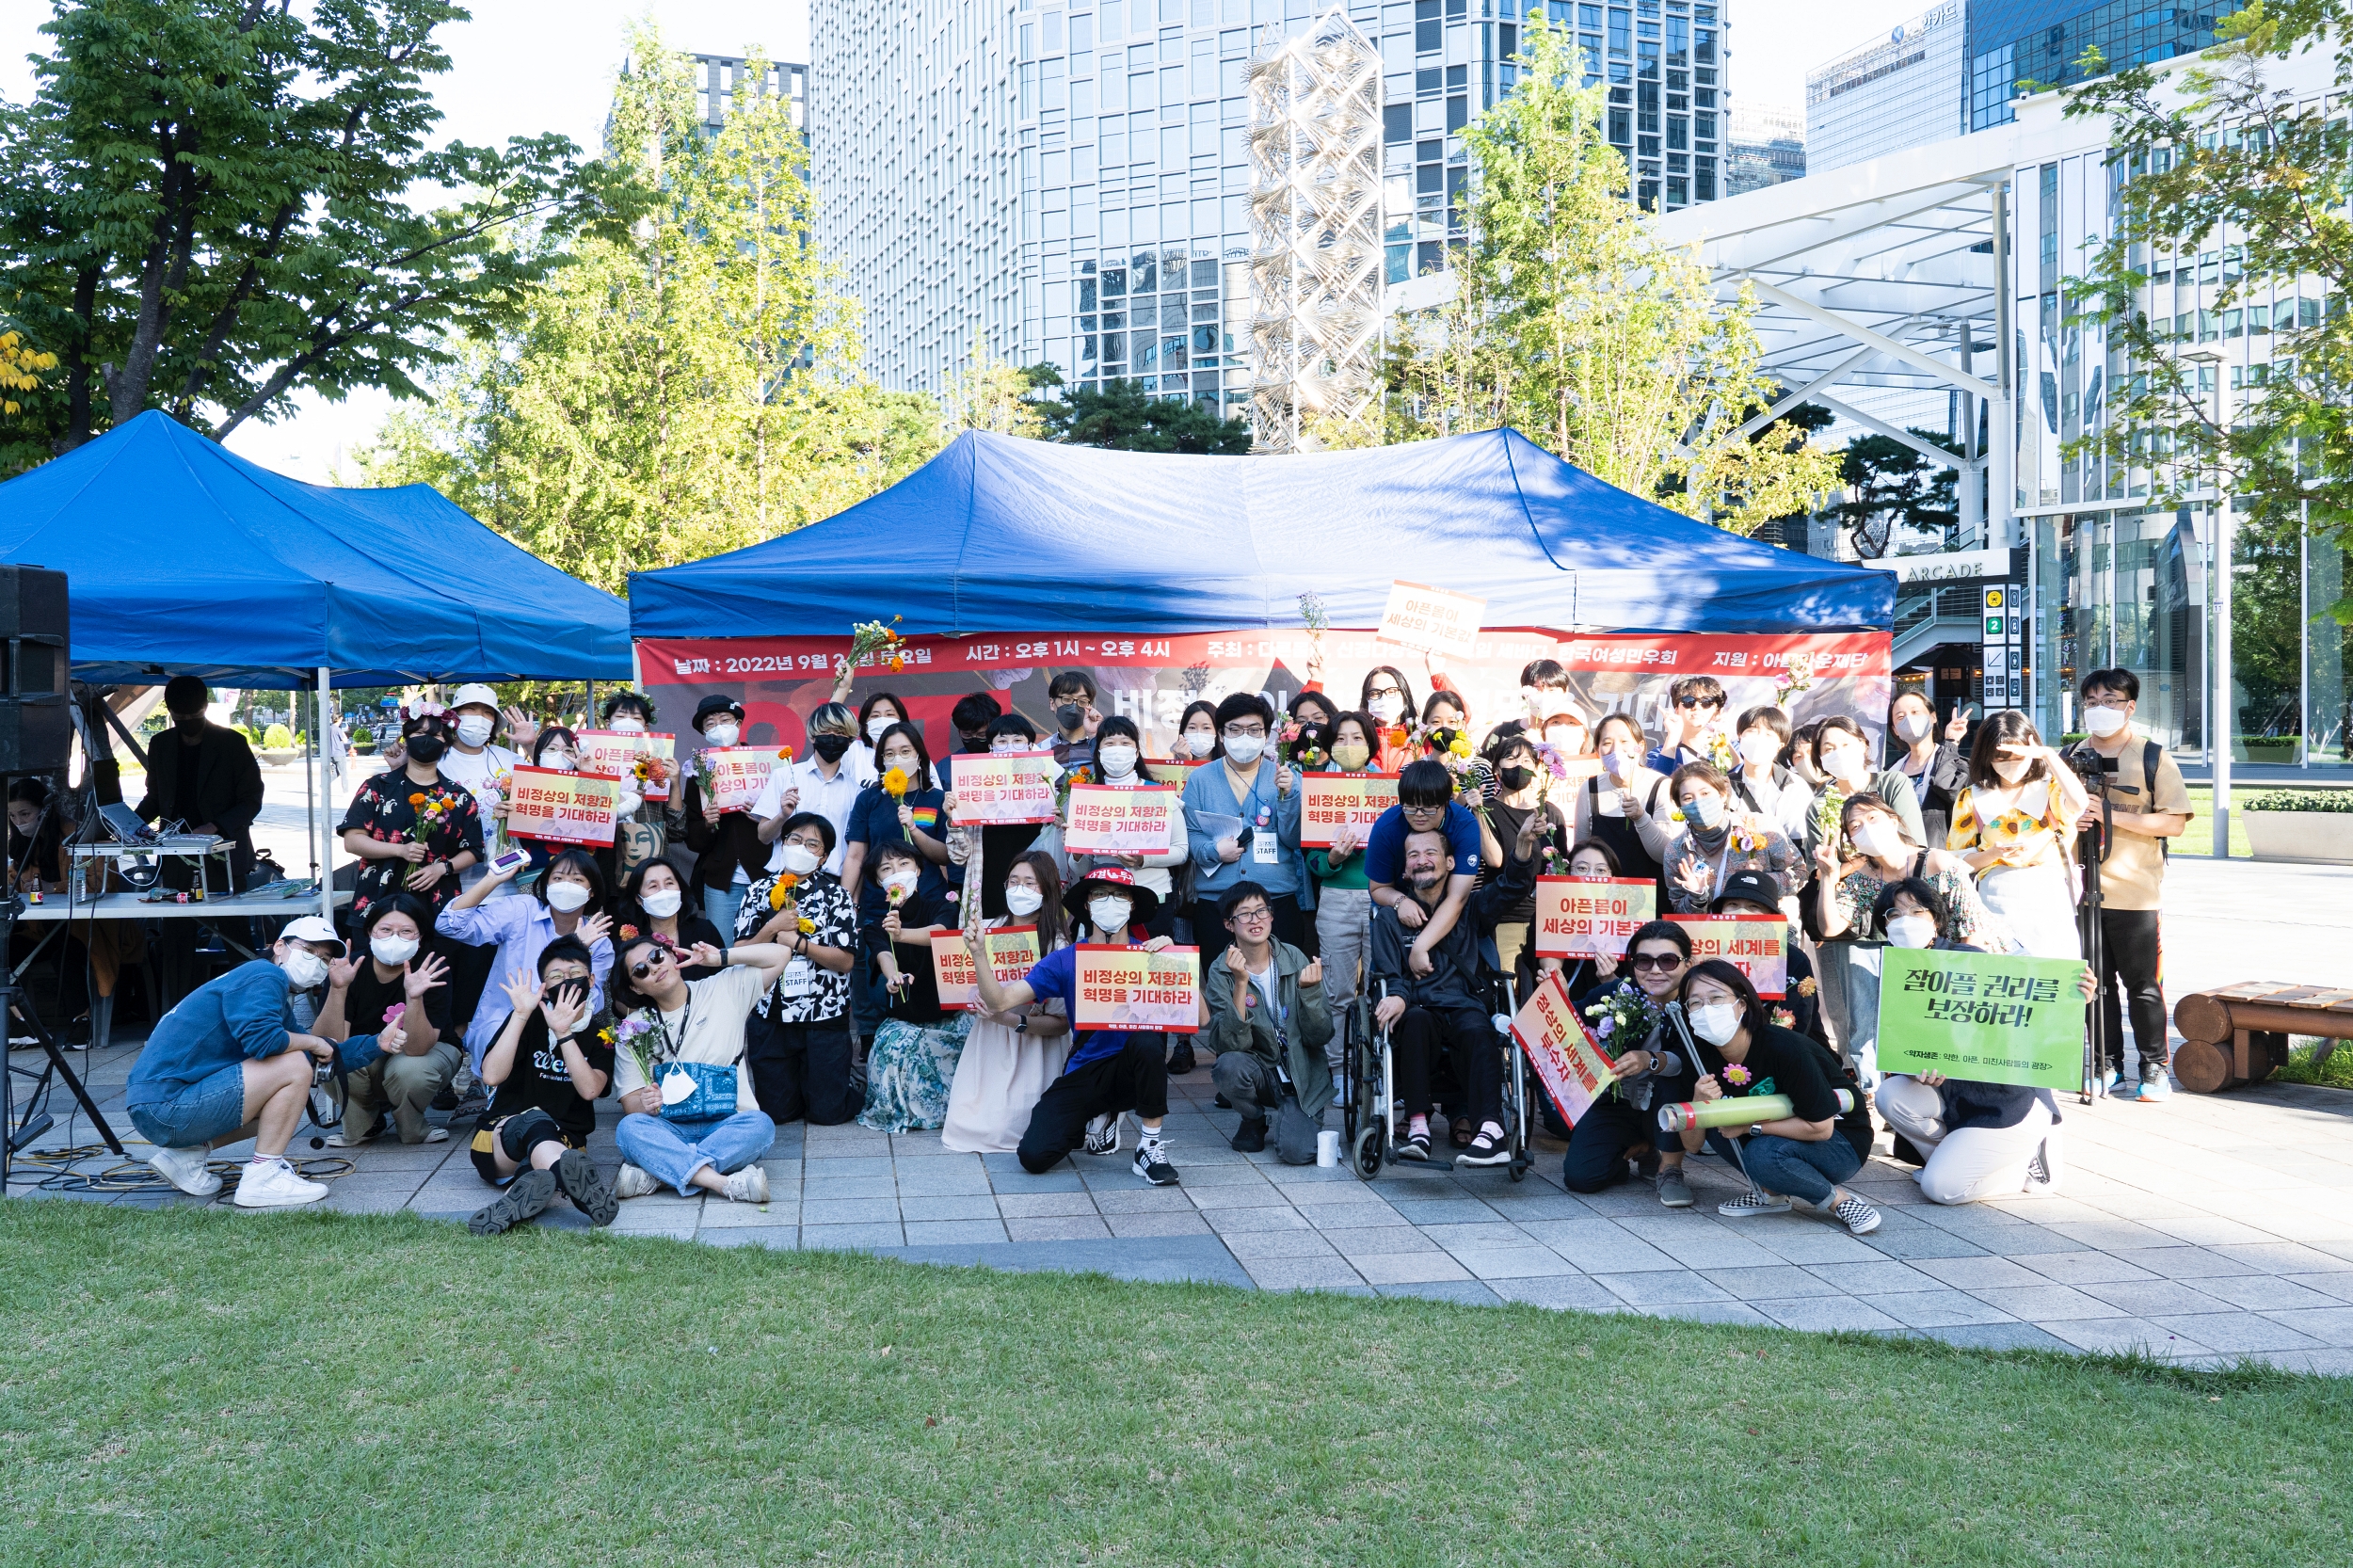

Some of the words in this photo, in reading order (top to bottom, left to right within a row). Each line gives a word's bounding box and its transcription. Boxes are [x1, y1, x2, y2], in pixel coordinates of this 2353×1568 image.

[1906, 562, 1983, 583] ARCADE
[1405, 600, 1459, 623] 아픈몸이
[1387, 613, 1427, 632] 세상의
[1991, 620, 1999, 630] 2
[966, 644, 1000, 662] 시간
[1016, 642, 1049, 659] 오후
[1053, 641, 1080, 657] 1시
[1100, 640, 1136, 657] 오후
[1141, 641, 1171, 658] 4시
[1208, 641, 1242, 658] 주최
[1557, 645, 1678, 665] 한국여성민우회
[1712, 650, 1747, 667] 지원
[674, 658, 711, 675] 날짜
[727, 655, 793, 673] 2022년
[797, 654, 828, 669] 9월
[833, 650, 875, 668] 2일
[716, 761, 772, 776] 아픈몸이
[957, 775, 1008, 787] 비정상의
[517, 787, 569, 804] 비정상의
[573, 792, 613, 808] 저항과
[958, 790, 996, 803] 혁명을
[1000, 787, 1049, 801] 기대하라
[1308, 794, 1360, 808] 비정상의
[1554, 791, 1577, 804] 기대
[515, 802, 554, 818] 혁명을
[558, 808, 611, 824] 기대하라
[1075, 804, 1127, 818] 비정상의
[1129, 806, 1168, 818] 저항과
[1307, 809, 1347, 824] 혁명을
[1351, 811, 1382, 824] 기대
[1074, 819, 1112, 833] 혁명을
[1115, 821, 1167, 833] 기대하라
[1560, 897, 1628, 916] 아픈몸이
[1543, 918, 1593, 936] 세상의
[1690, 938, 1721, 956] 상의
[1727, 939, 1781, 956] 세계를
[939, 954, 976, 968] 비정상
[993, 950, 1034, 965] 저항과
[785, 978, 808, 986] STAFF
[941, 971, 978, 984] 혁명을
[991, 967, 1034, 983] 대하라
[1083, 969, 1143, 985] 비정상의
[1147, 971, 1193, 986] 저항과
[1903, 968, 1977, 997] 잘아플
[1983, 974, 2060, 1003] 권리를
[1083, 987, 1128, 1003] 혁명을
[1132, 989, 1193, 1005] 기대하라
[1924, 998, 2033, 1028] 보장하라!
[1536, 992, 1567, 1044] 정상의
[1564, 1043, 1598, 1094] 세계를
[1541, 1031, 1571, 1083] 부수자
